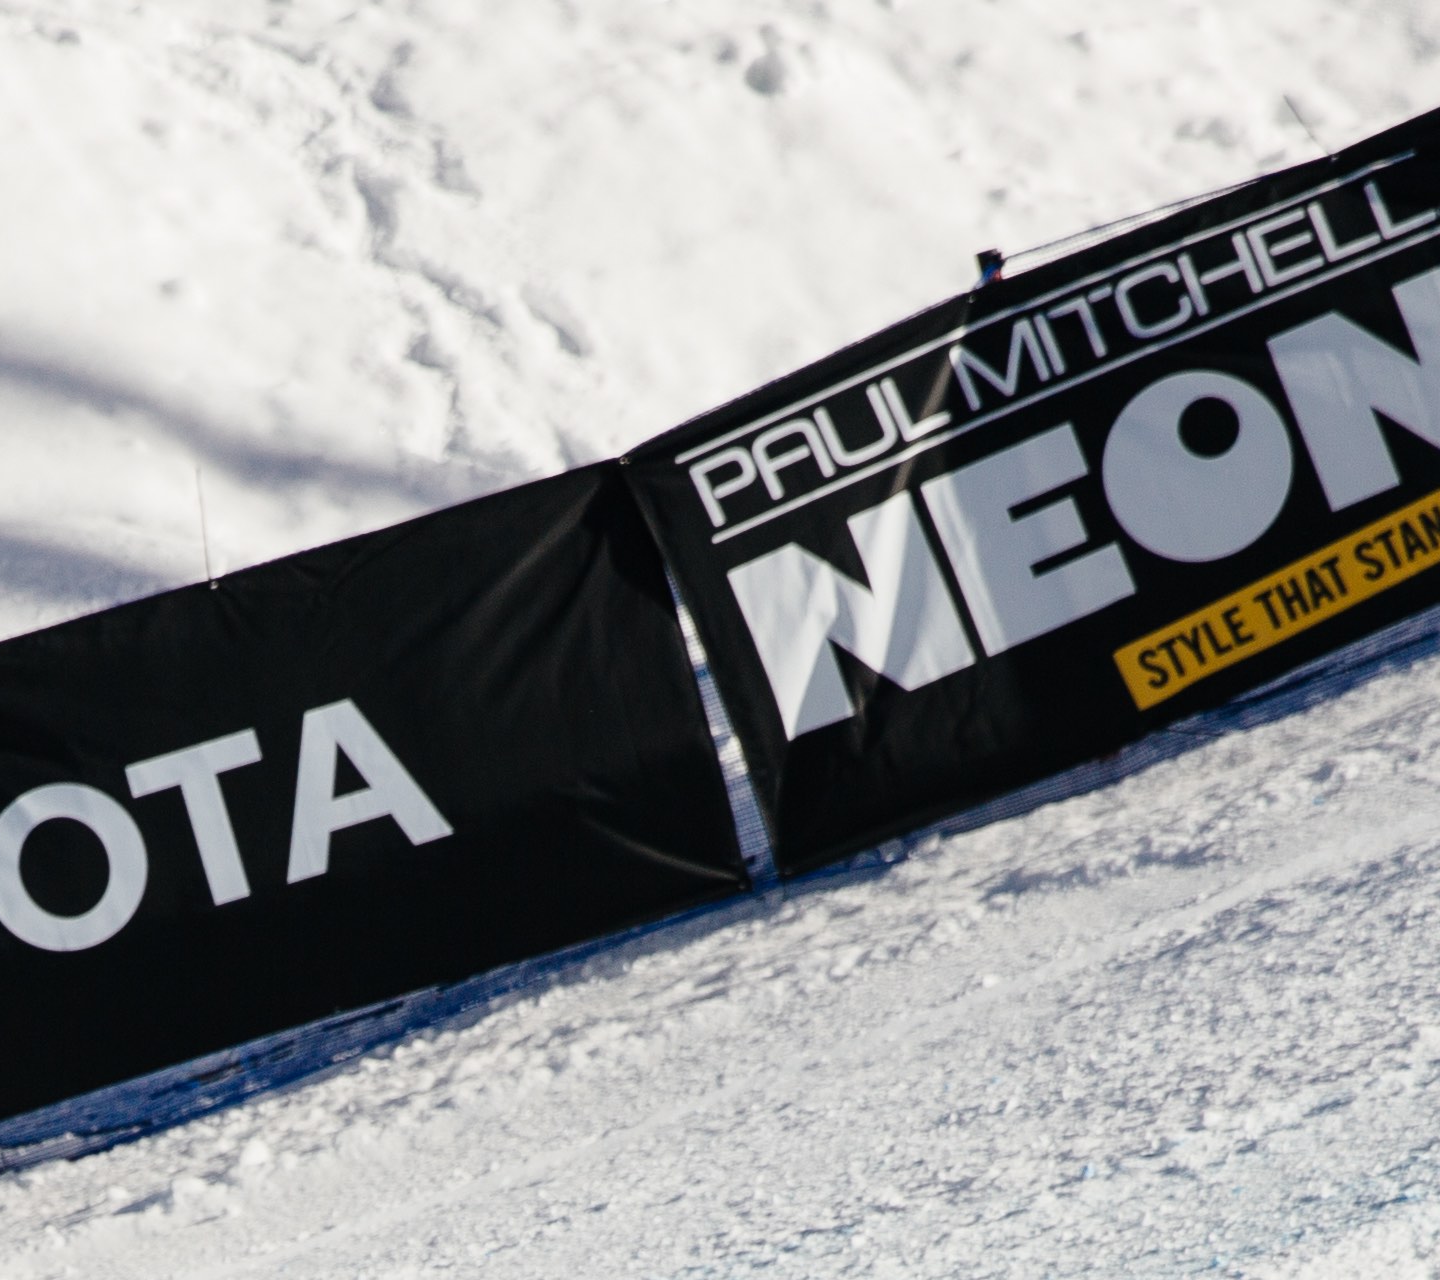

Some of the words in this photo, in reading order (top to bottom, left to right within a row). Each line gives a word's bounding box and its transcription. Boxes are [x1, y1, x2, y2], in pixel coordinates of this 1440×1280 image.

[689, 377, 951, 528] PAUL
[948, 181, 1438, 411] MITCHELL
[1137, 606, 1255, 690] STYLE
[1253, 557, 1350, 630] THAT
